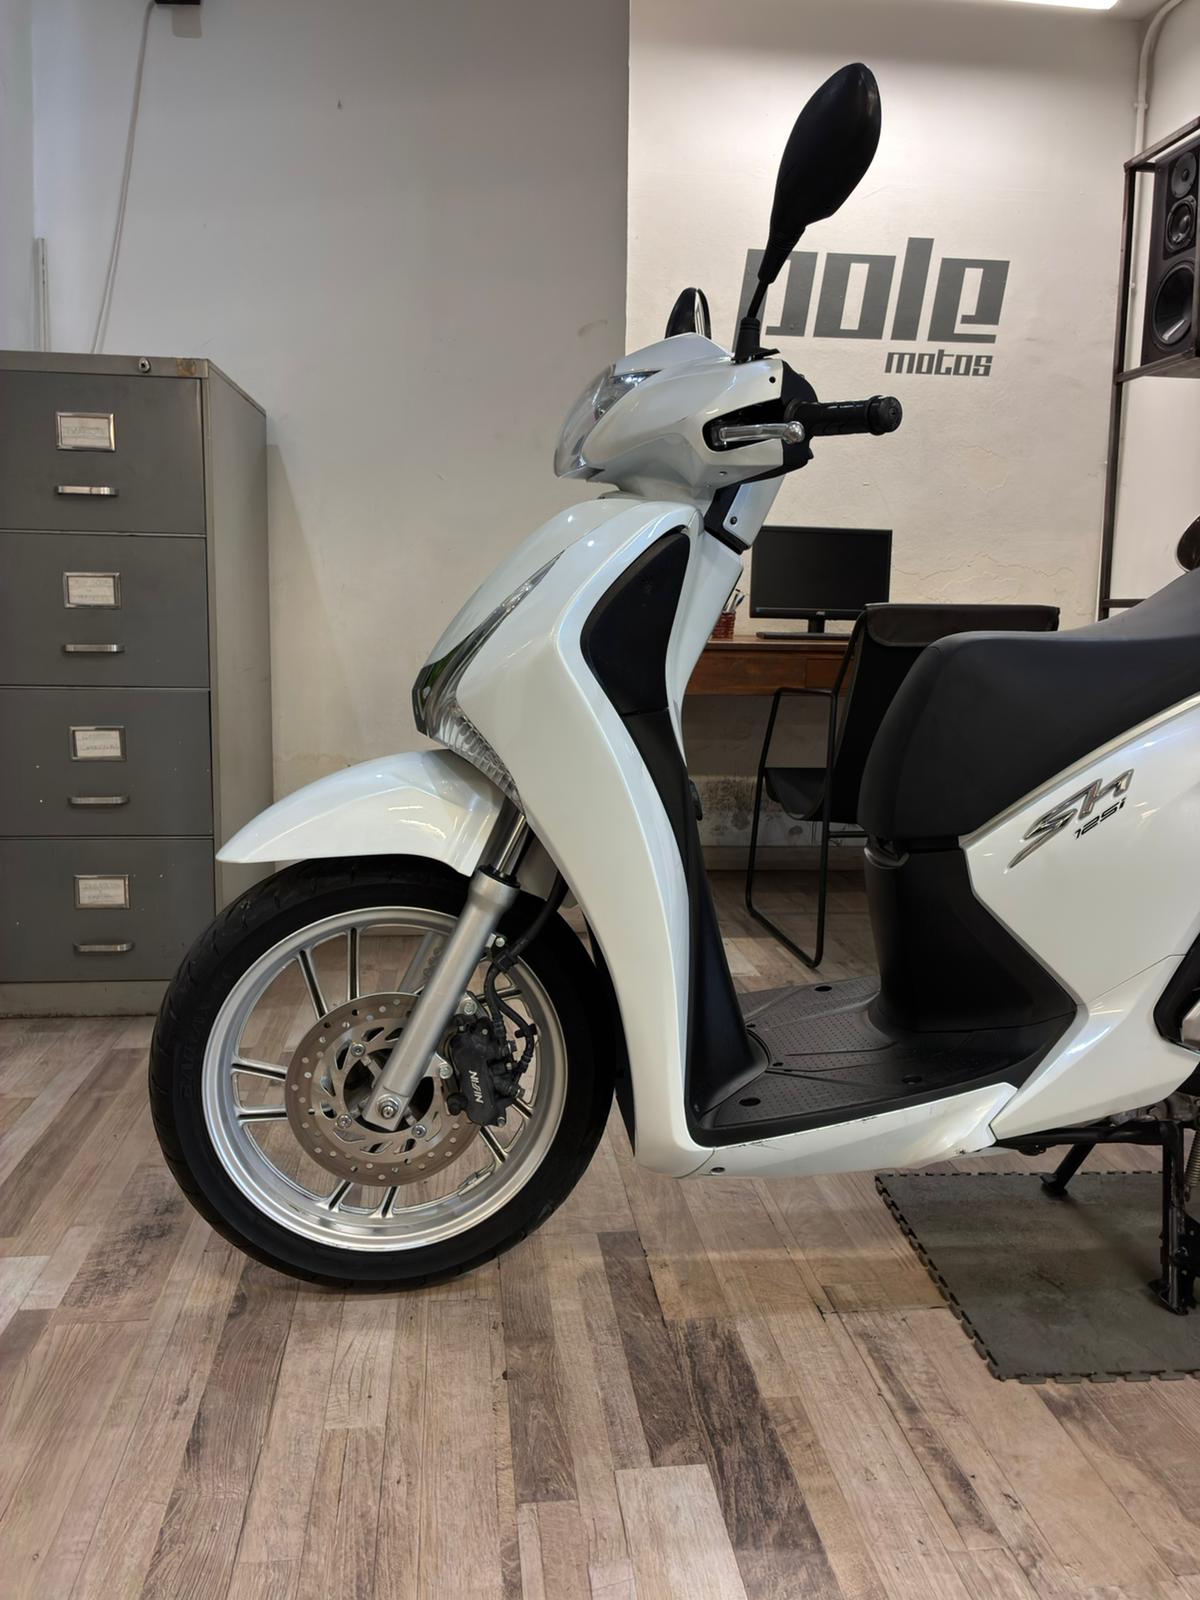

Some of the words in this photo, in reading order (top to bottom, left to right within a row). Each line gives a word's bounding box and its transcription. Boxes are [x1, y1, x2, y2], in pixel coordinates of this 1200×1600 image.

[732, 237, 1010, 353] pole
[884, 349, 993, 377] motos
[1073, 797, 1127, 840] 125i
